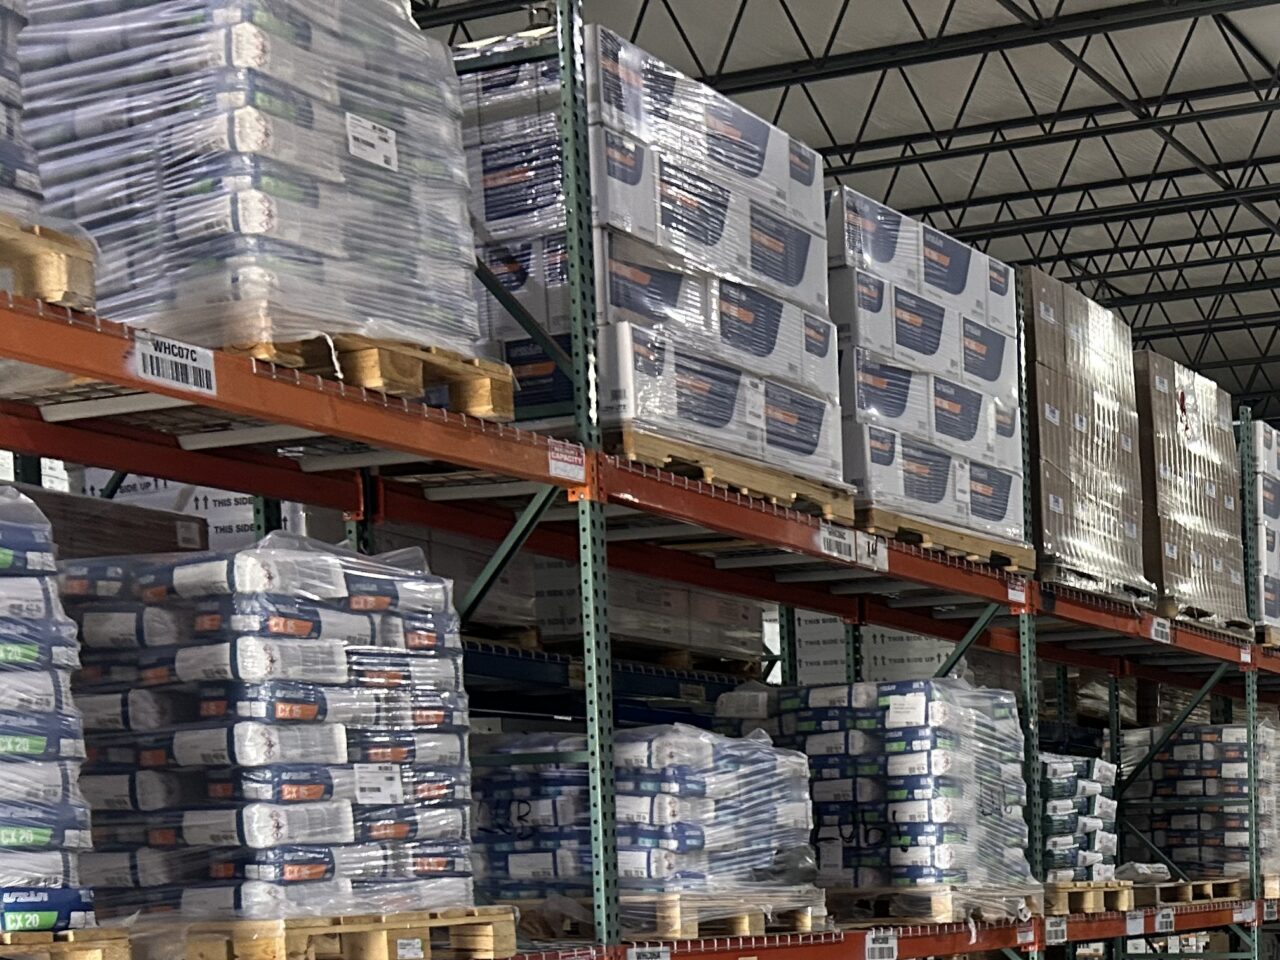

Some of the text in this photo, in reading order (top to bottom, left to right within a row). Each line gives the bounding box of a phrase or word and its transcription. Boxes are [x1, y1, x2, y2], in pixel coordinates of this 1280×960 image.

[153, 340, 197, 362] WHC07C
[119, 481, 151, 494] SIDE UP
[213, 496, 253, 507] THIS SIDE
[214, 523, 255, 534] THIS SIDE
[277, 703, 290, 719] CX
[15, 736, 29, 751] 20
[283, 785, 297, 800] CX
[17, 829, 33, 844] 20
[7, 913, 40, 928] CX 20
